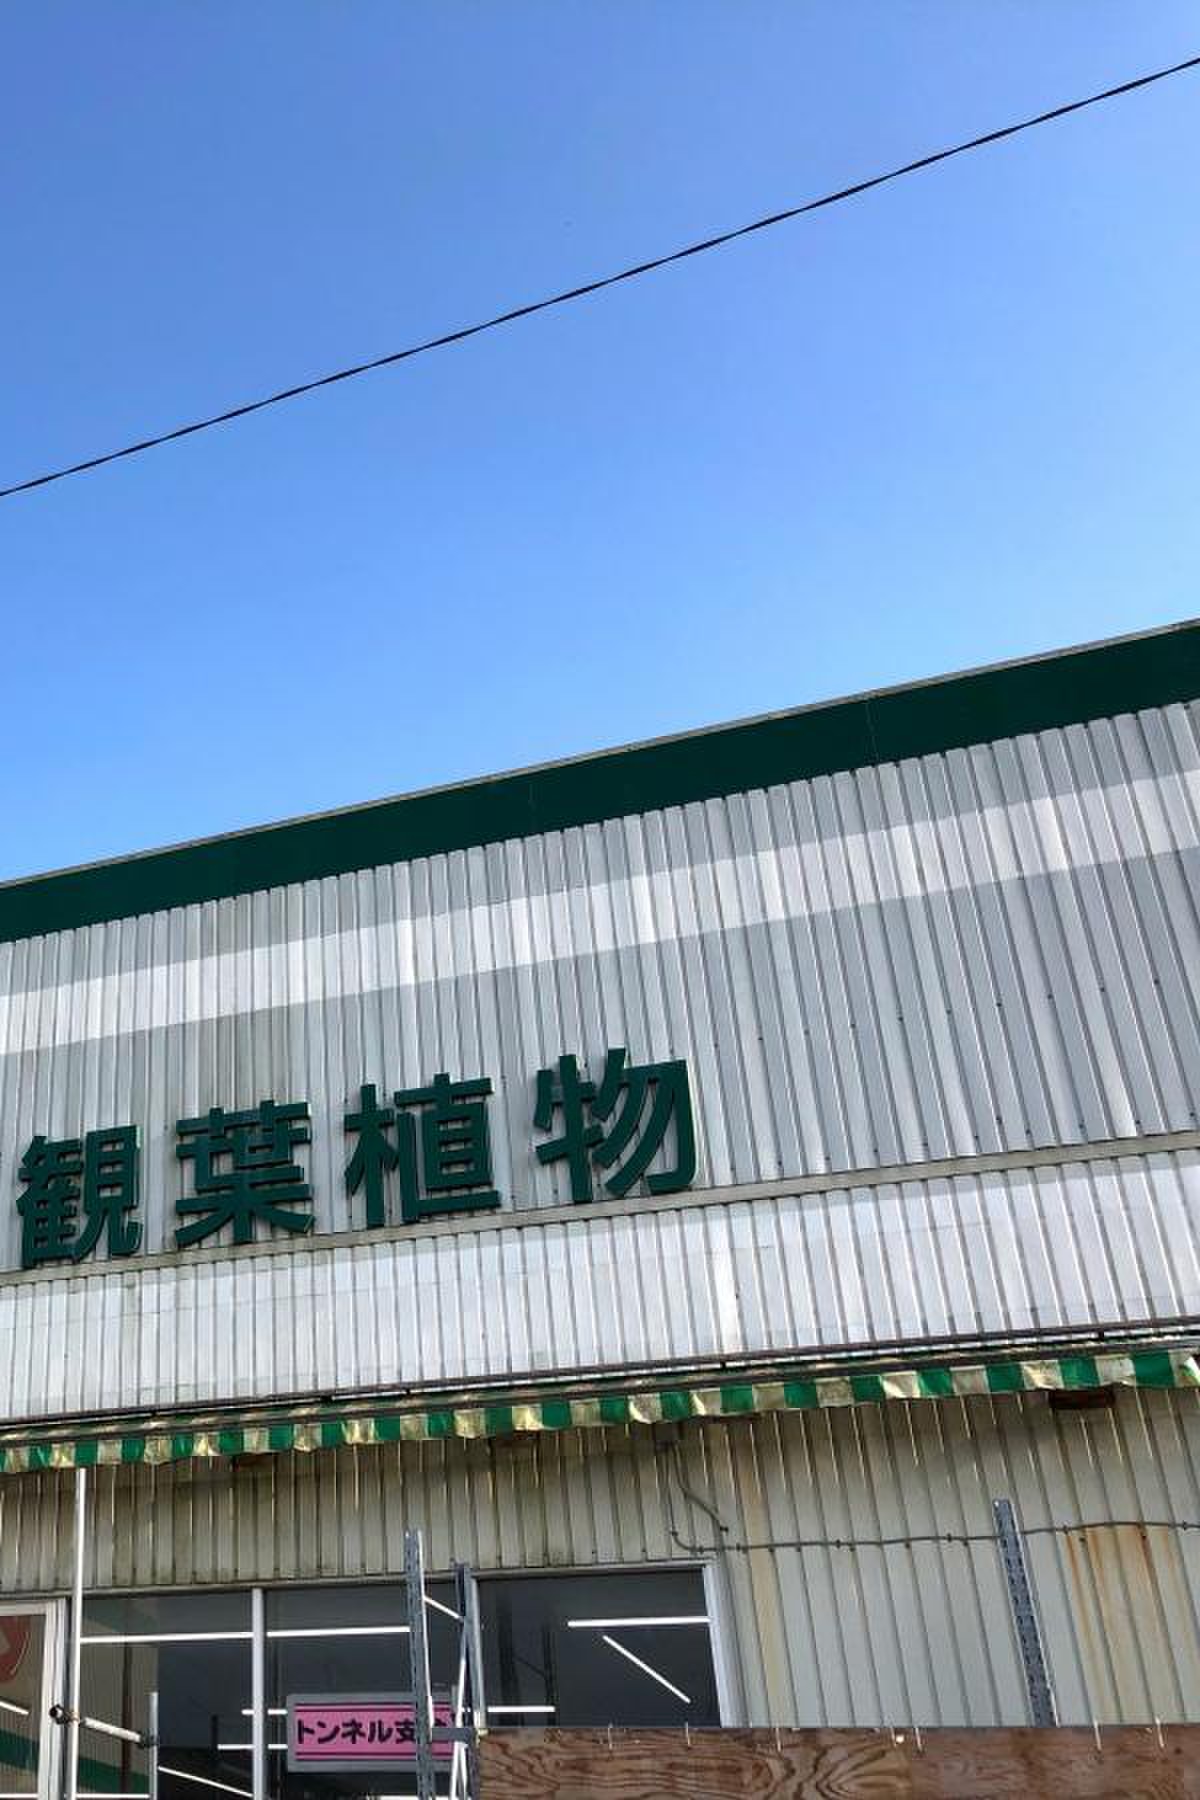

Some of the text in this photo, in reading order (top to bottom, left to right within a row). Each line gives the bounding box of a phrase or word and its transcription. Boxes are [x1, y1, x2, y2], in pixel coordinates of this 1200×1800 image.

[297, 1718, 448, 1744] トンネル支
